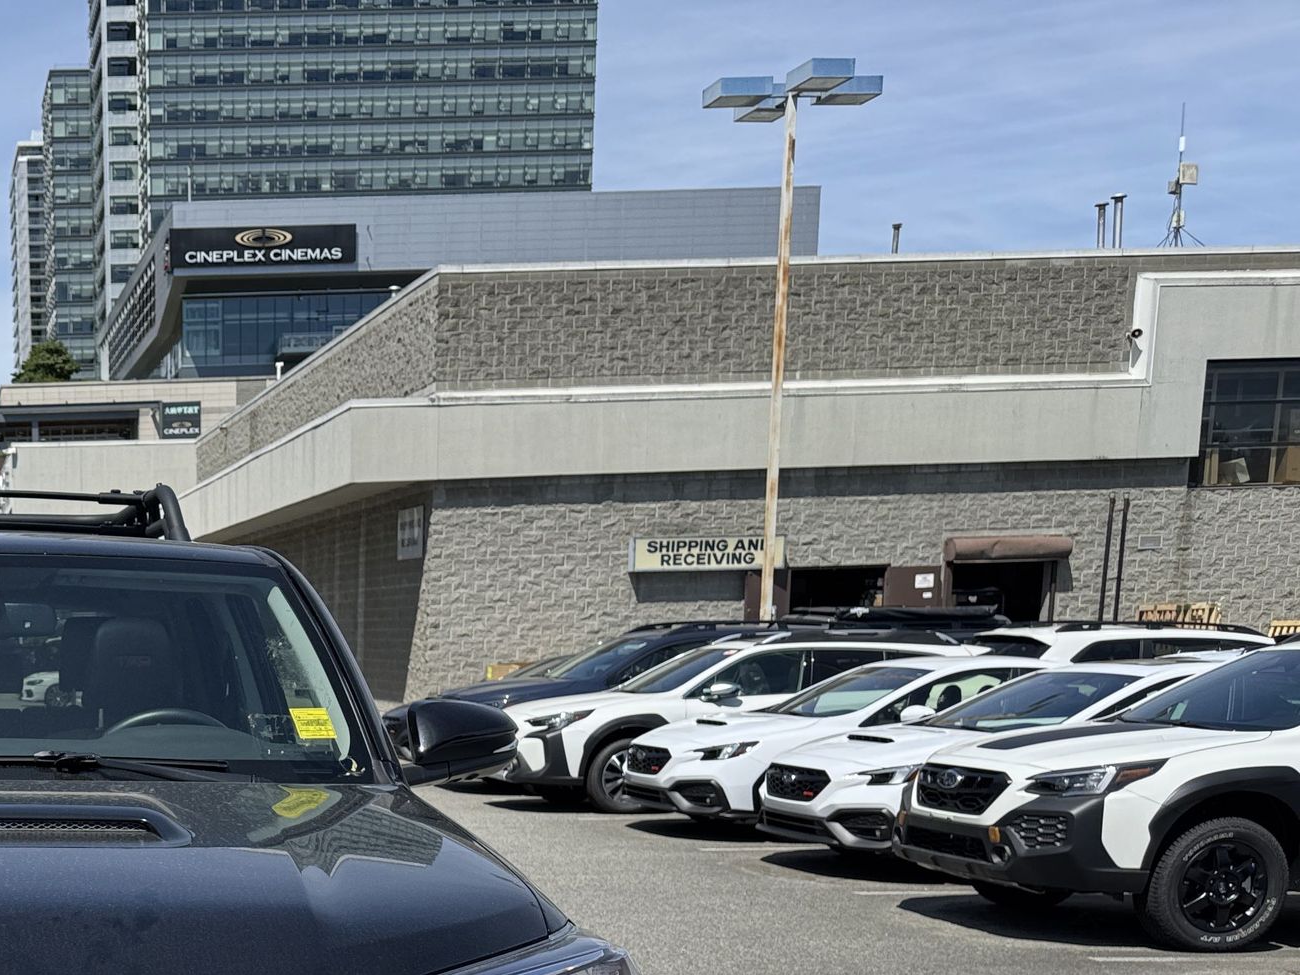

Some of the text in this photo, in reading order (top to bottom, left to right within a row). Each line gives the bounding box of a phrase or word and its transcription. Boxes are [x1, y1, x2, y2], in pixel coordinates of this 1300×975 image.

[184, 247, 342, 264] CINEPLEX CINEMAS
[646, 539, 728, 553] SHIPPING
[660, 552, 756, 566] RECEIVING
